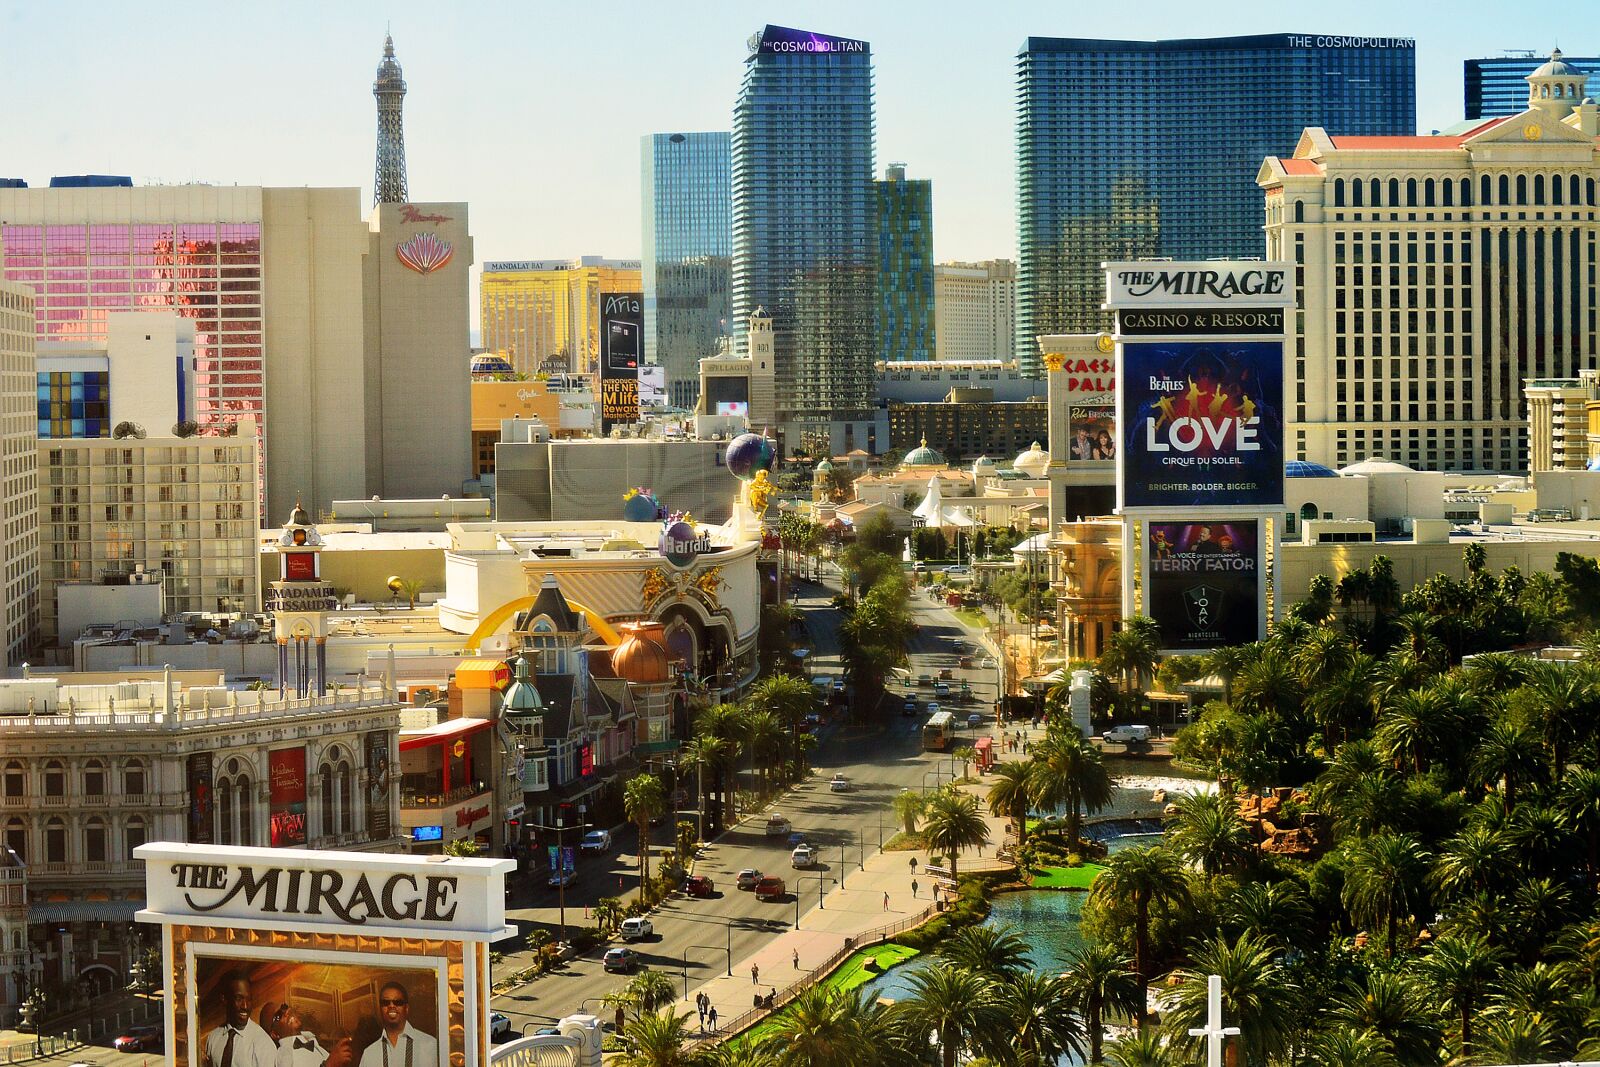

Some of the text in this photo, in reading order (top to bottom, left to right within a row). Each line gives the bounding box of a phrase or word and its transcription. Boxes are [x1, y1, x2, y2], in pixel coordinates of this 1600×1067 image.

[773, 41, 863, 52] COSMOPOLITAN
[1287, 36, 1414, 48] THE COSMOPOLITAN
[491, 262, 530, 270] MANDALAY
[1118, 270, 1285, 298] THE MIRAGE
[605, 295, 640, 314] Aria
[1124, 313, 1282, 328] CASINO & RESORT
[603, 384, 620, 392] THE
[1149, 375, 1184, 392] BEATLES
[603, 392, 616, 404] M
[1146, 416, 1260, 452] LOVE
[1162, 456, 1243, 467] CIRQUE DU SOLEIL
[1148, 482, 1258, 491] BRIGHTER. BOLDER. BIGGER.
[1152, 558, 1255, 571] TERRY FATOR
[171, 864, 458, 924] THE MIRAGE
